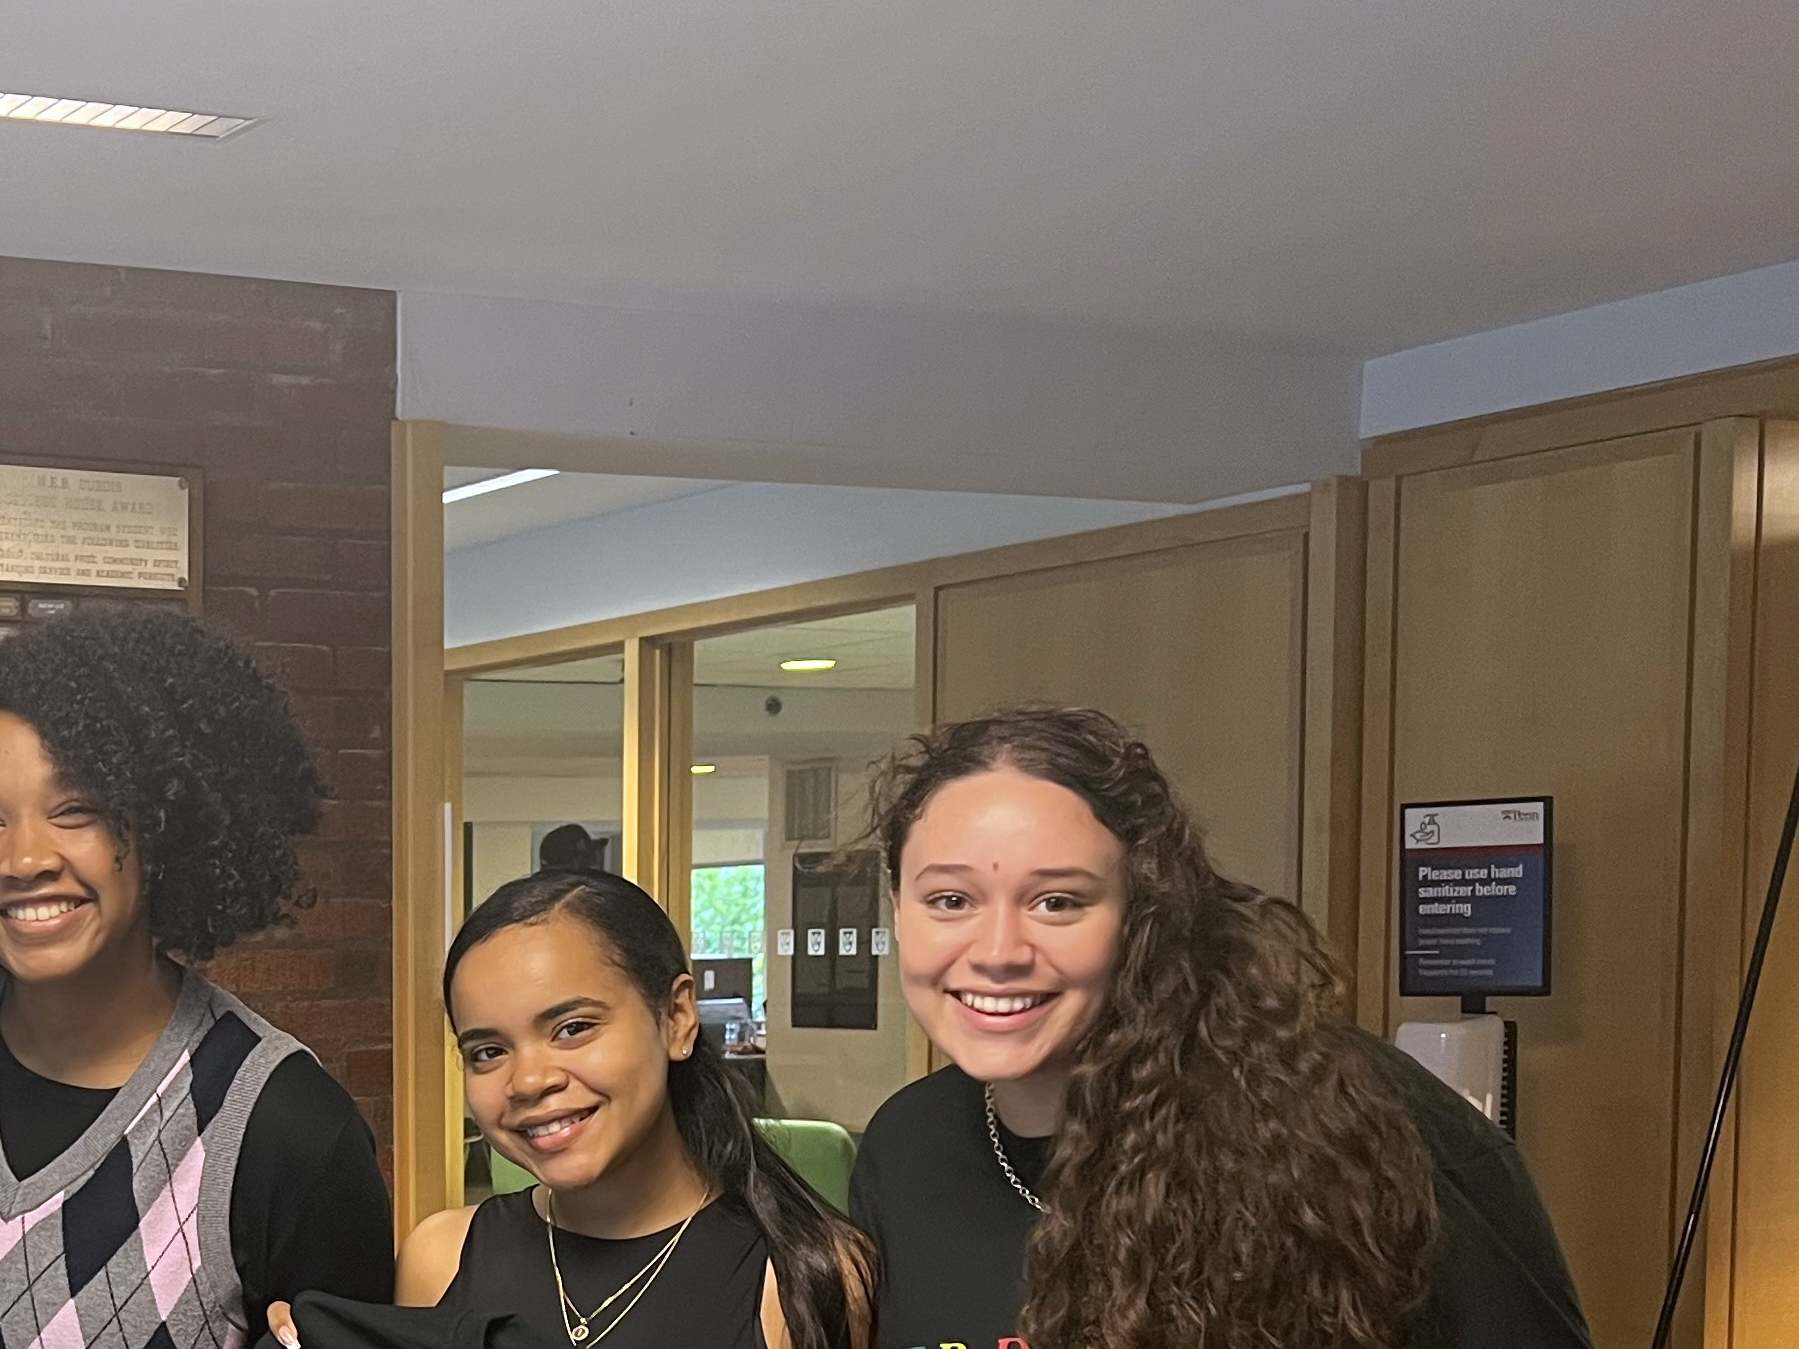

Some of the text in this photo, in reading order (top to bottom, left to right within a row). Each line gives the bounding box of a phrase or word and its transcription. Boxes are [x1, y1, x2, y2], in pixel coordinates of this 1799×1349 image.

[1418, 863, 1524, 881] Please use hand
[1418, 881, 1517, 898] sanitizer before
[1418, 899, 1473, 918] entering
